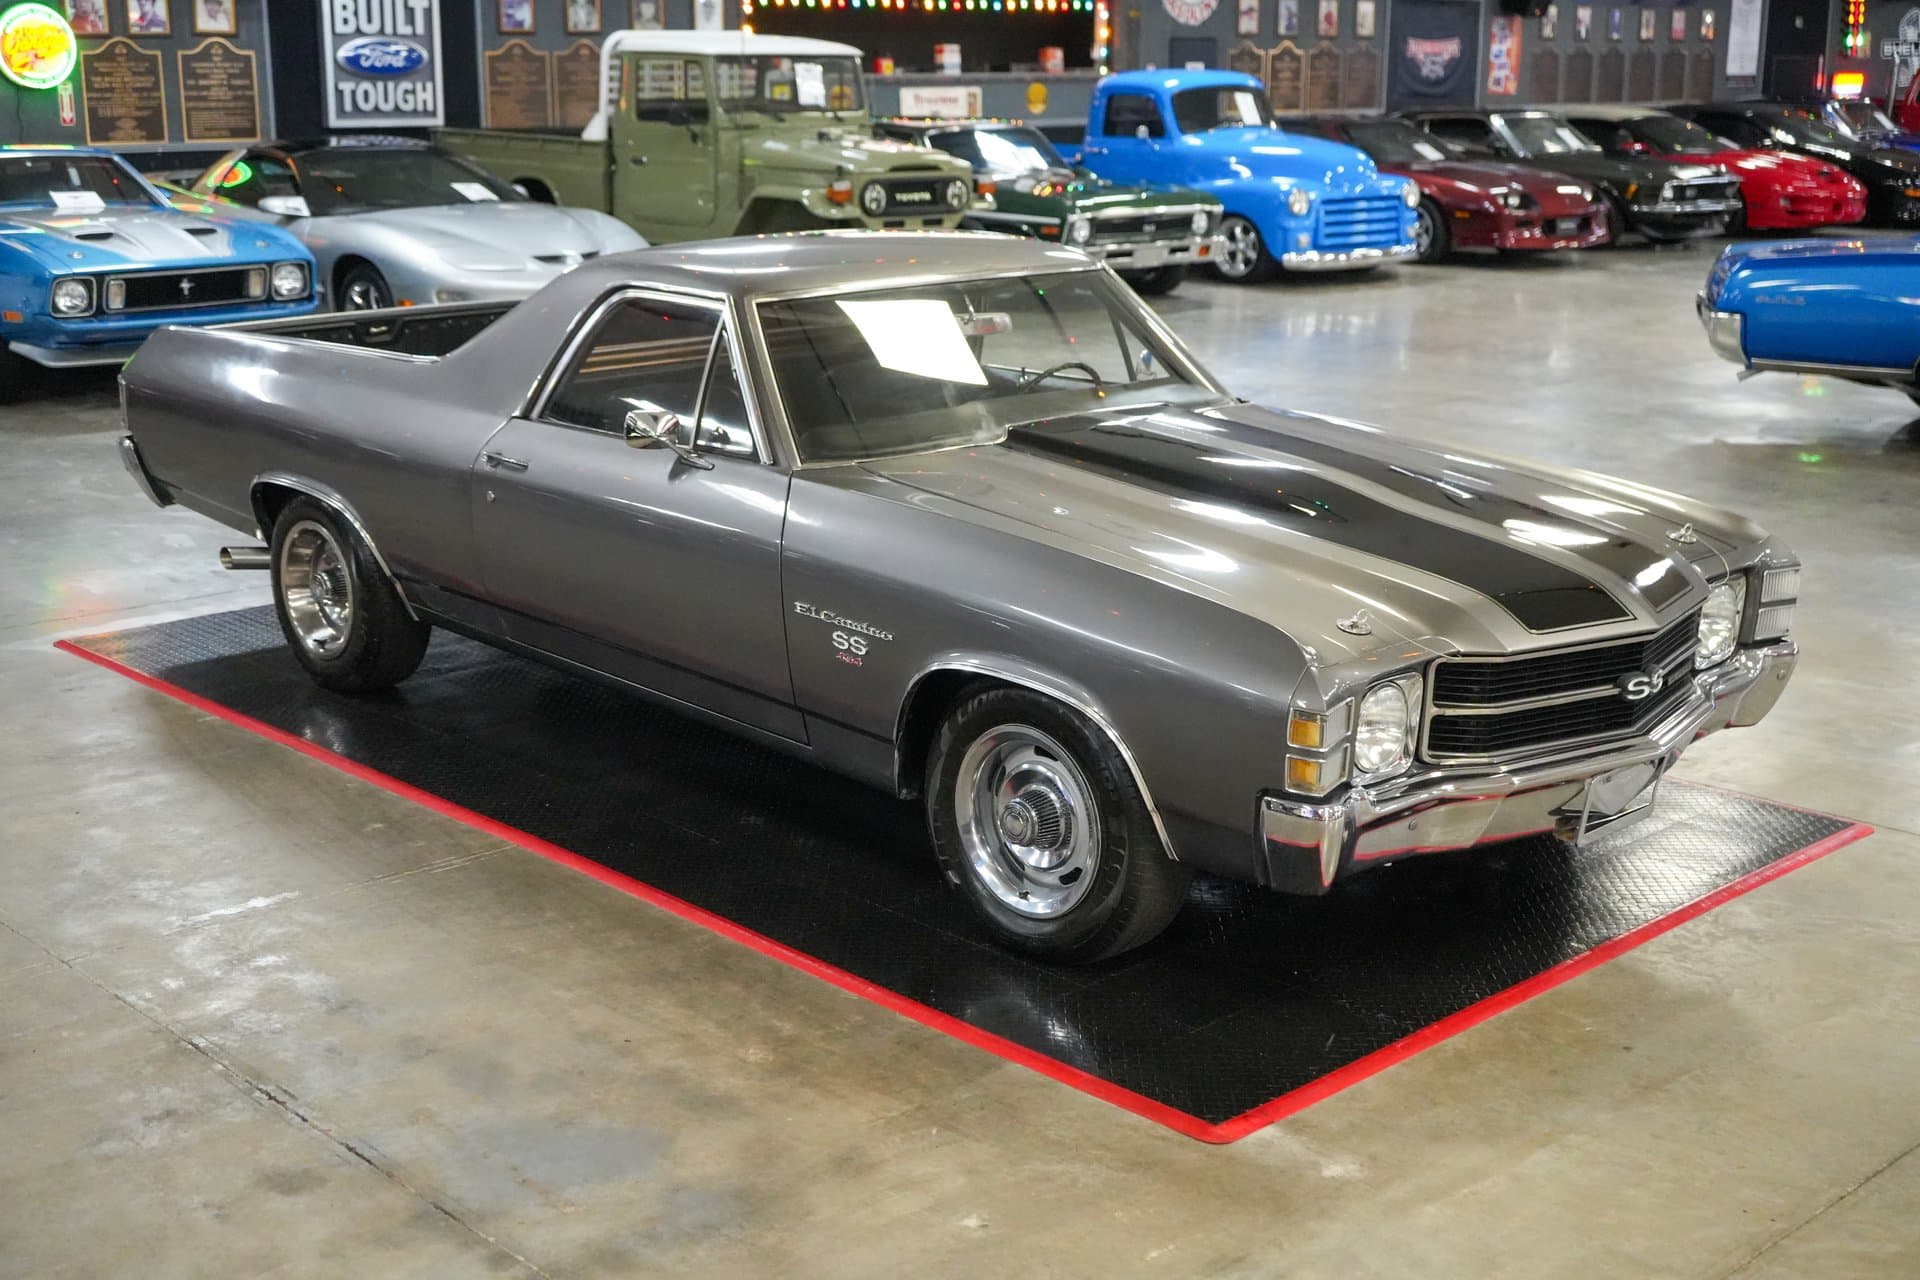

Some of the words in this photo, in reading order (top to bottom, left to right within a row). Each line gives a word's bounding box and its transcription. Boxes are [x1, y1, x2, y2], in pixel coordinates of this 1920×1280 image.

[333, 0, 430, 35] BUILT
[354, 44, 409, 68] Ford
[337, 81, 435, 113] TOUGH
[894, 188, 932, 203] TOYOTA
[831, 630, 869, 656] SS
[1626, 668, 1664, 700] SS
